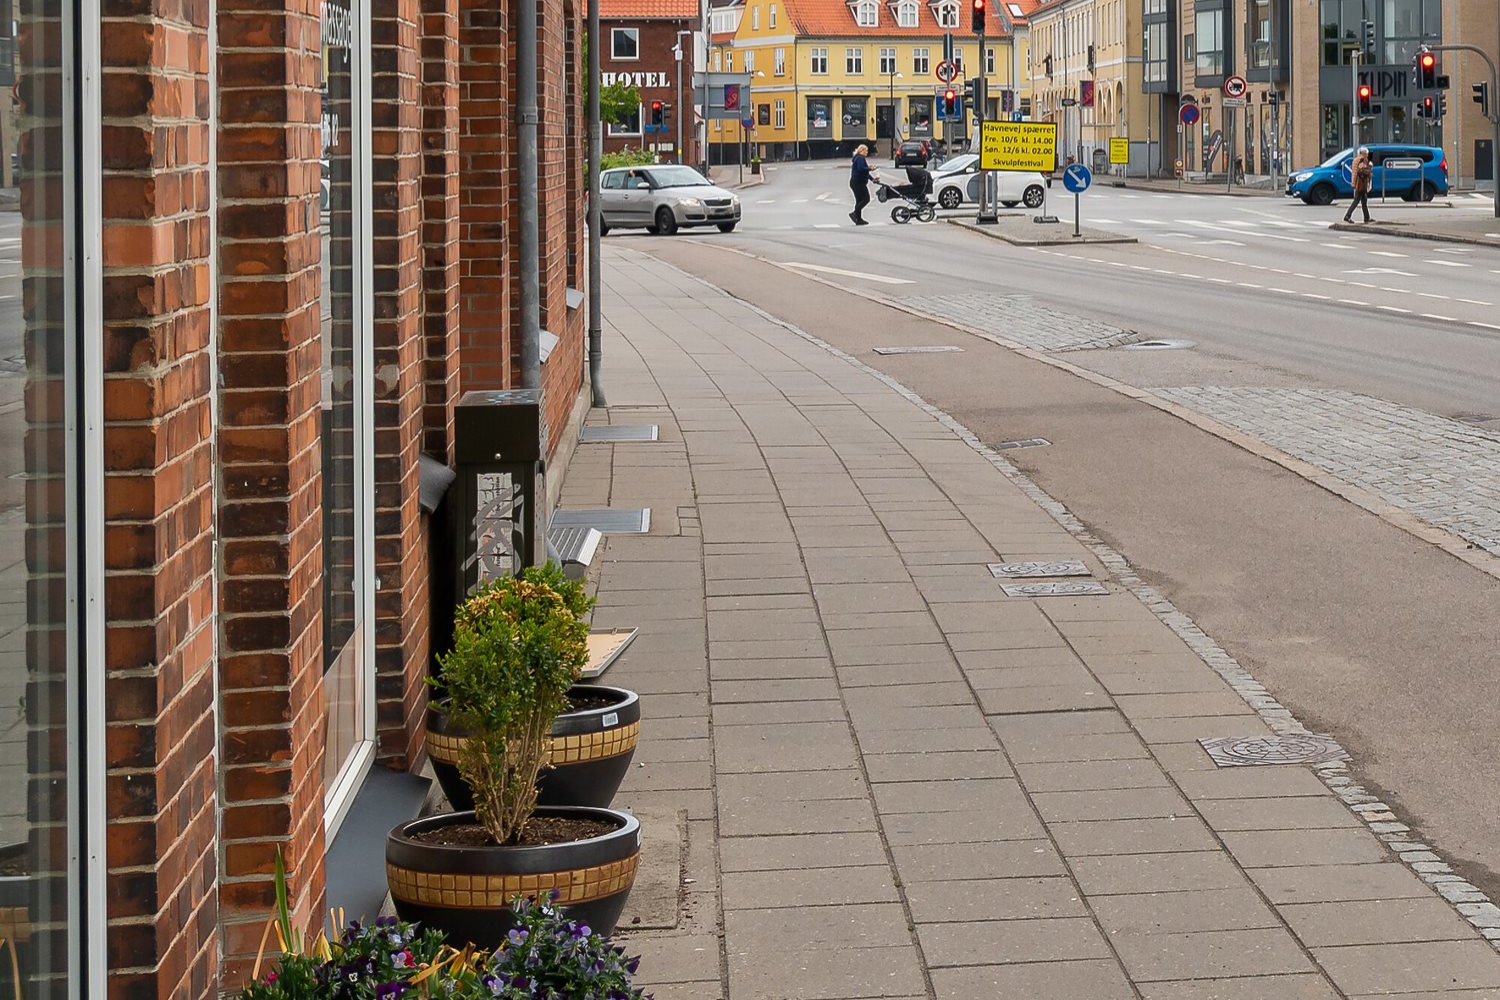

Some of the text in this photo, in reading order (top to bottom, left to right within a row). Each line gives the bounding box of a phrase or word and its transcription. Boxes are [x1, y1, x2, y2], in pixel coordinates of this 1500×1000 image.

[320, 1, 352, 63] massage
[602, 72, 670, 88] HOTEL
[983, 124, 1055, 134] Havnevej spærret
[1001, 135, 1018, 144] 10/6
[1021, 136, 1030, 144] kl.
[1003, 146, 1020, 154] 12/6
[1032, 147, 1053, 155] 02.00
[993, 159, 1043, 167] Skvulpfestival
